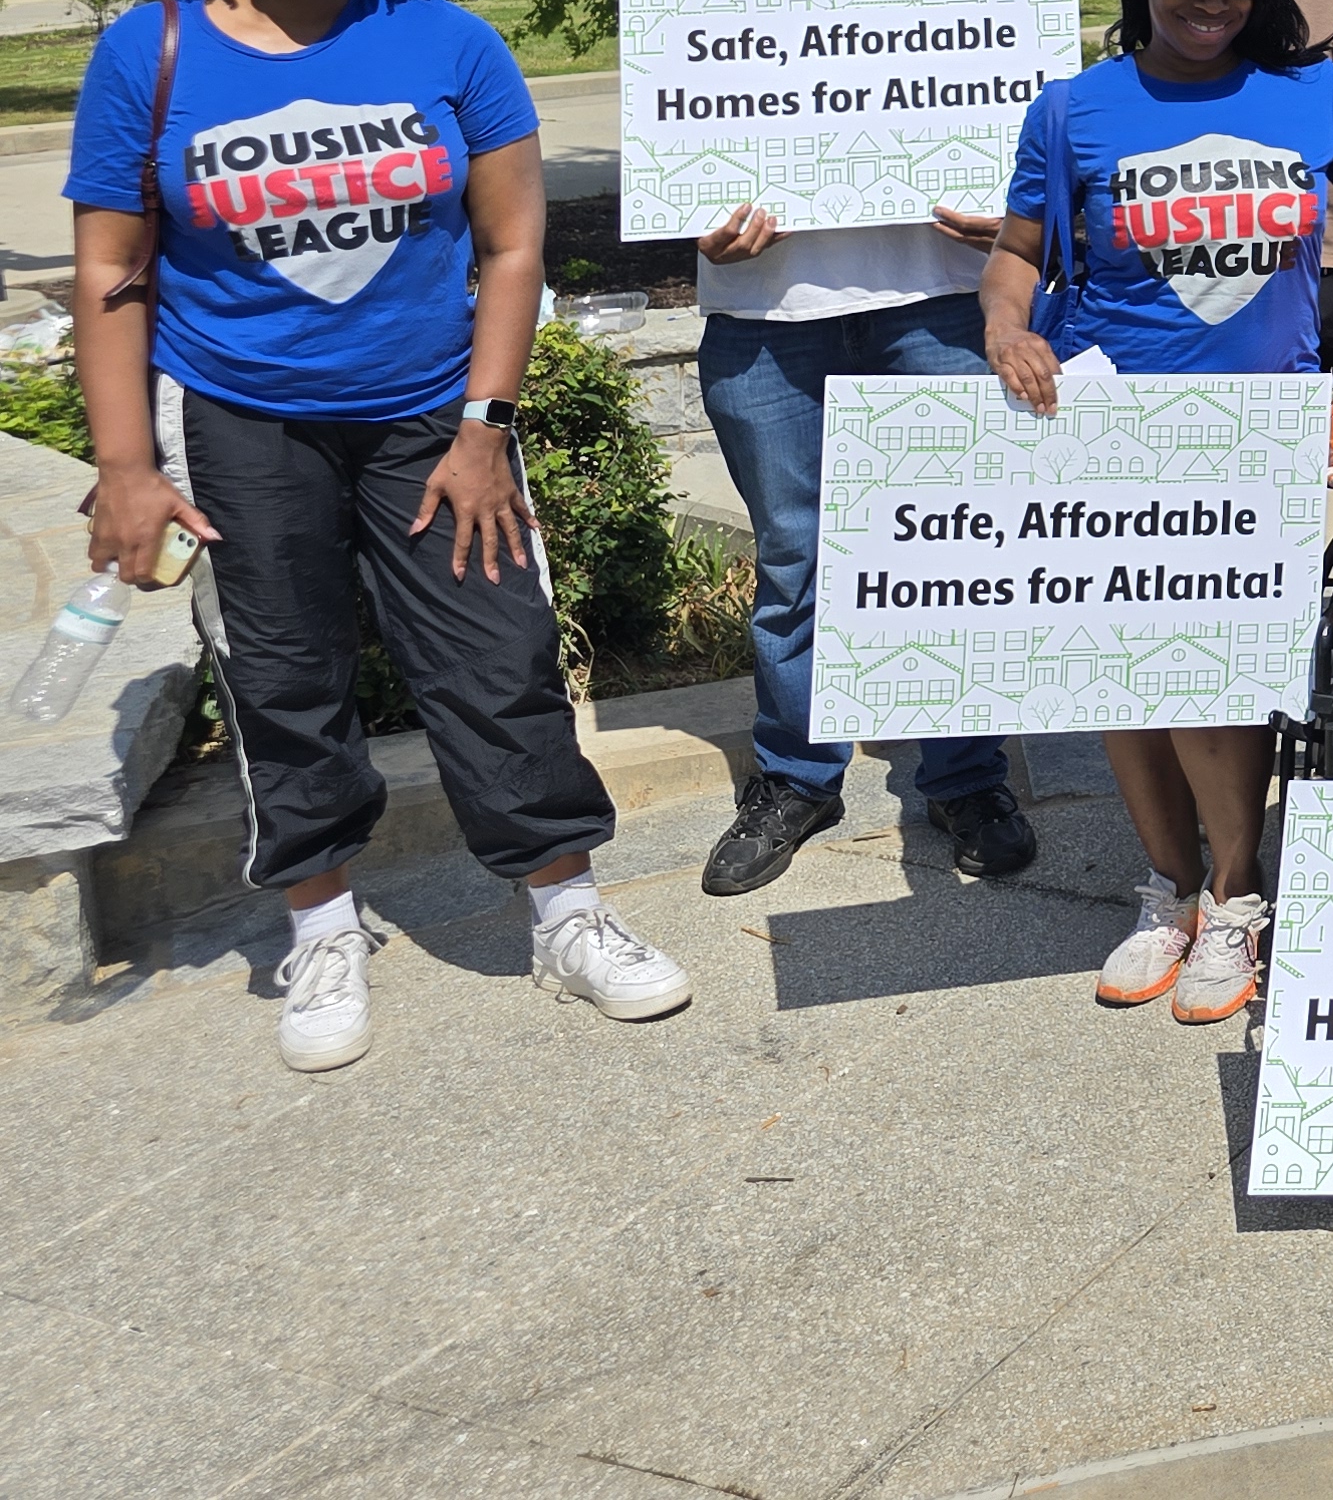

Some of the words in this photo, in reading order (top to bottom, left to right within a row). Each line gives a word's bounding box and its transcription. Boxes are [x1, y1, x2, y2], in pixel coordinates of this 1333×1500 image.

[686, 28, 788, 66] Safe,
[800, 18, 1016, 58] Affordable
[657, 88, 800, 122] Homes
[812, 82, 871, 114] for
[882, 70, 1044, 110] Atlanta!
[184, 111, 440, 182] HOUSING
[186, 145, 453, 228] JUSTICE
[1110, 159, 1316, 203] HOUSING
[228, 201, 433, 262] LEAGUE
[1112, 192, 1318, 250] JUSTICE
[1140, 239, 1300, 280] LEAGUE
[893, 502, 1006, 548] Safe,
[1018, 500, 1257, 540] Affordable
[856, 571, 1014, 610] Homes
[1028, 568, 1093, 604] for
[1104, 562, 1285, 602] Atlanta!
